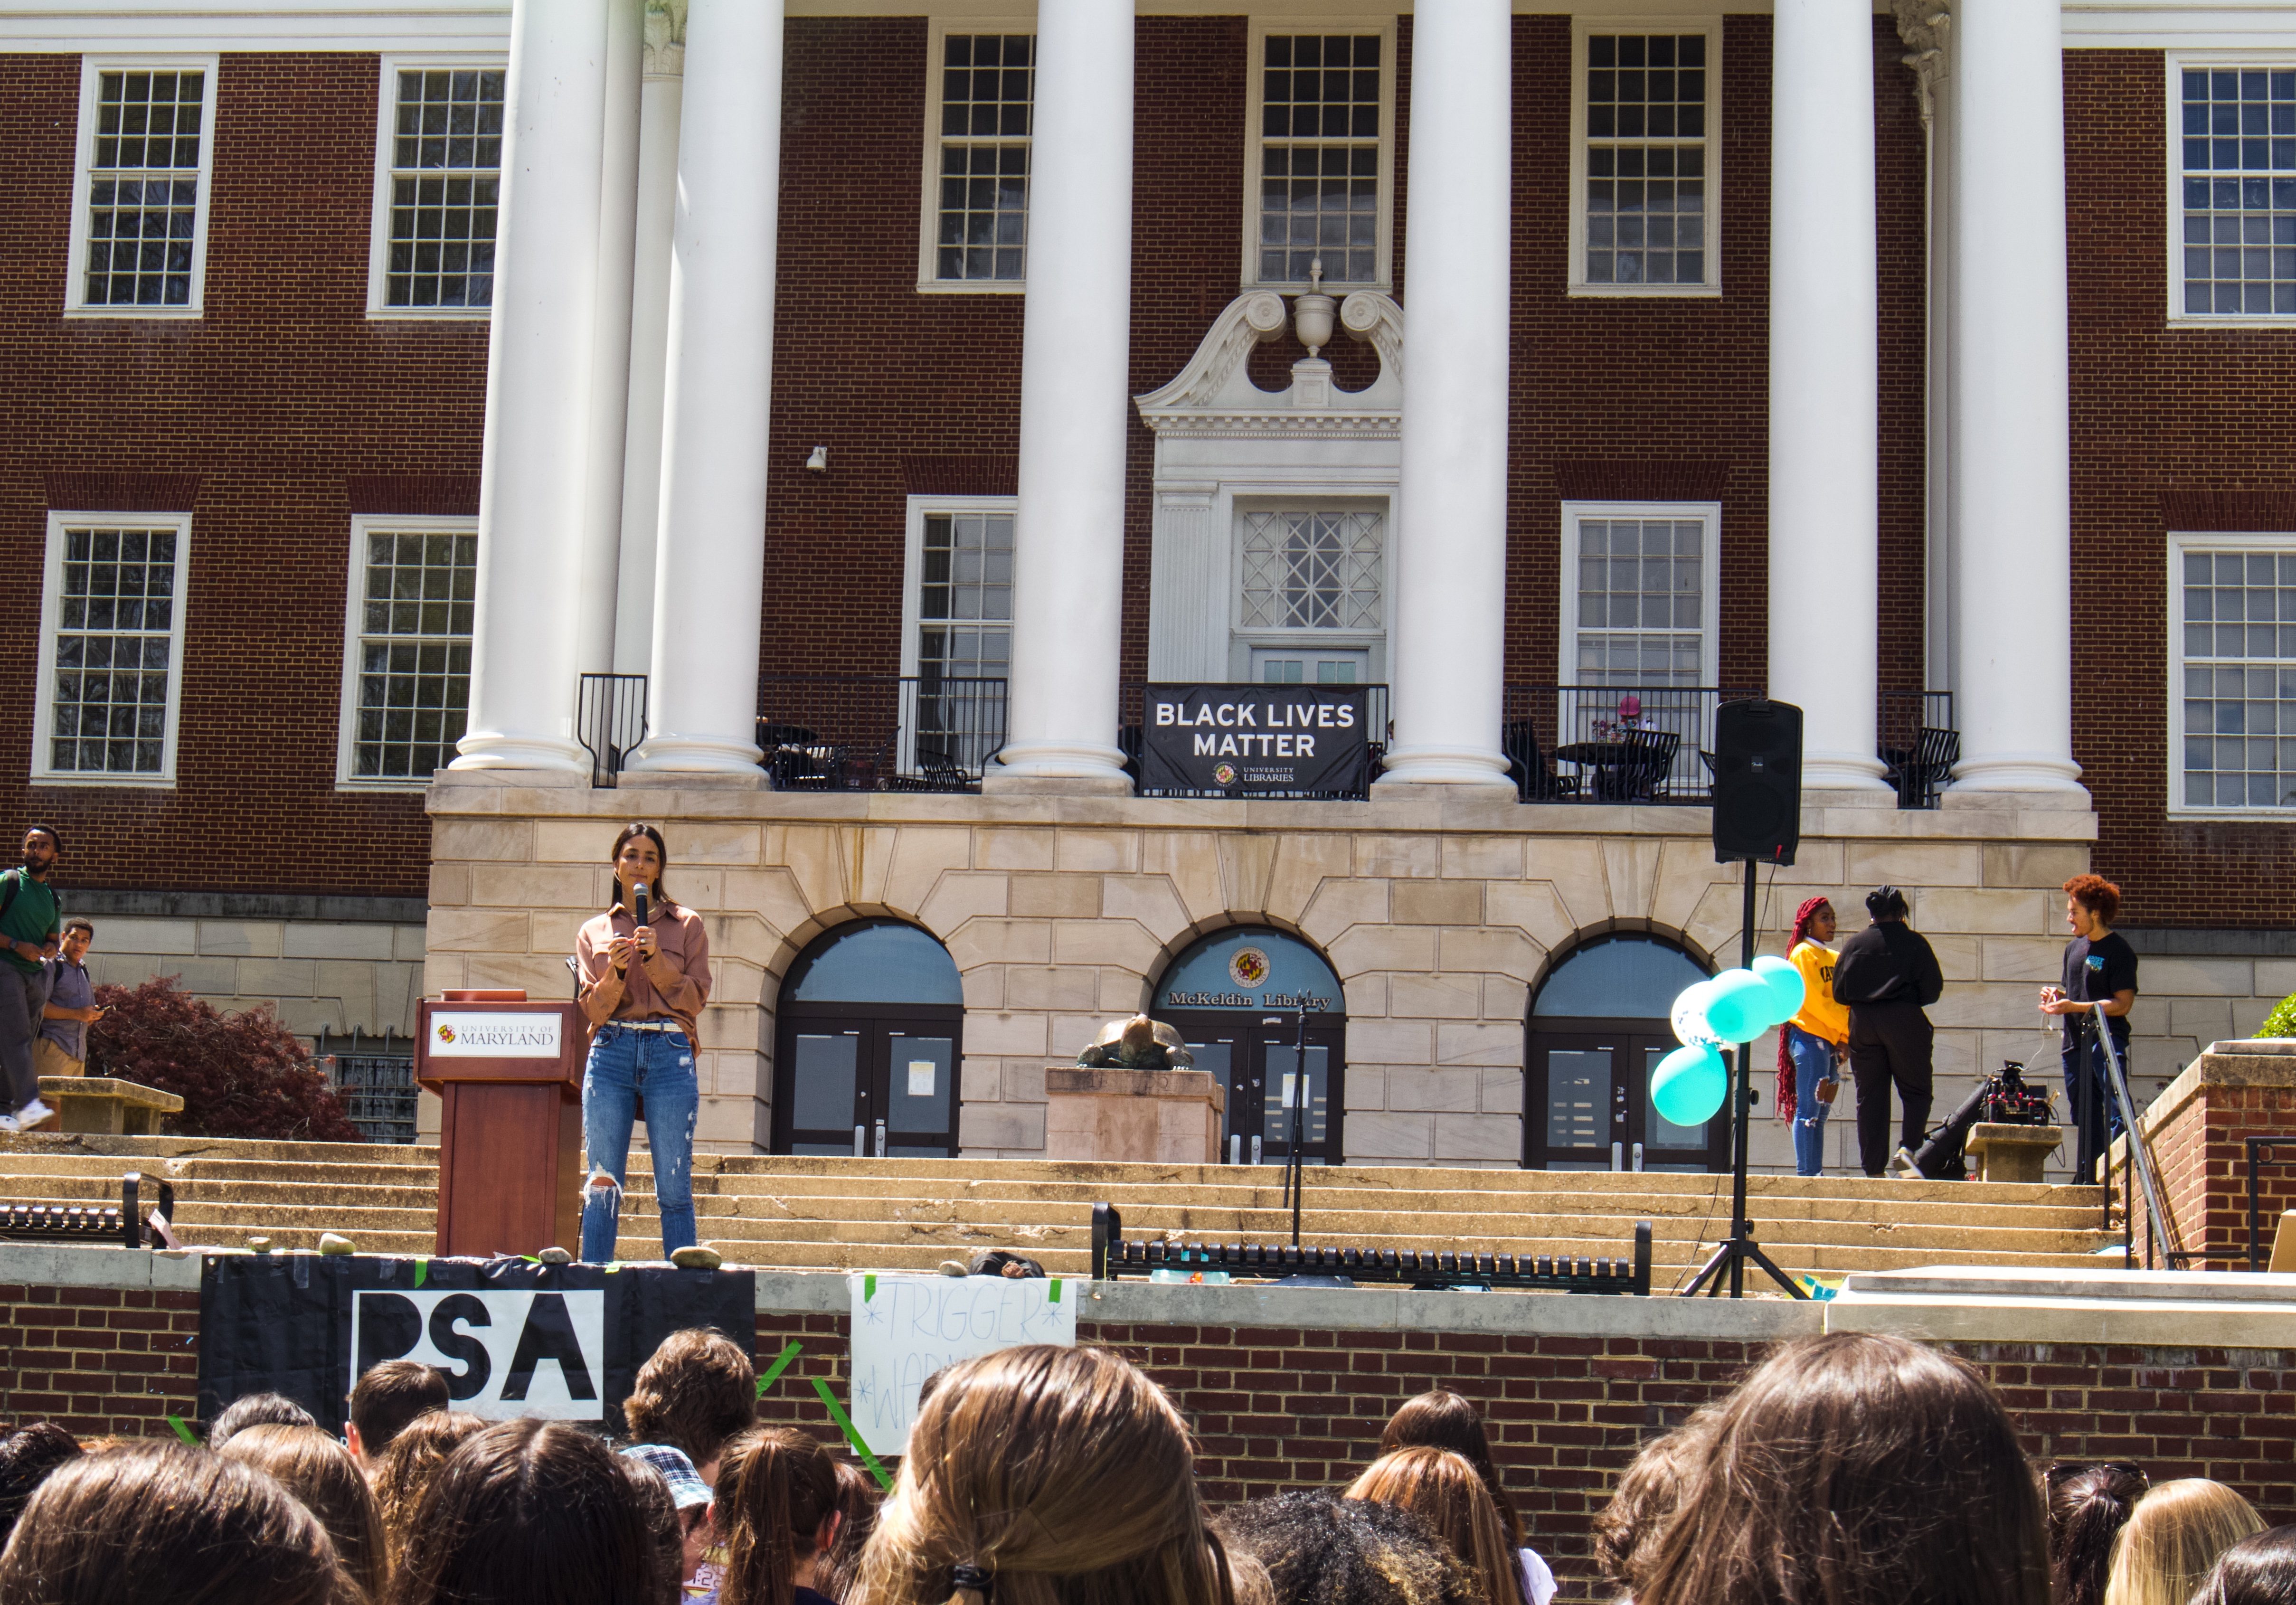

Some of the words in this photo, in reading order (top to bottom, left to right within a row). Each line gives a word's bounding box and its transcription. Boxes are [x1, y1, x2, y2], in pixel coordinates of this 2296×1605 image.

[1156, 703, 1257, 726] BLACK
[1267, 704, 1354, 727] LIVES
[1194, 733, 1315, 757] MATTER
[1244, 774, 1294, 782] LIBRARIES
[1232, 973, 1267, 987] MARYLAND
[1169, 992, 1253, 1006] McKeldin
[461, 1033, 553, 1045] MARYLAND
[357, 1293, 598, 1400] PSA
